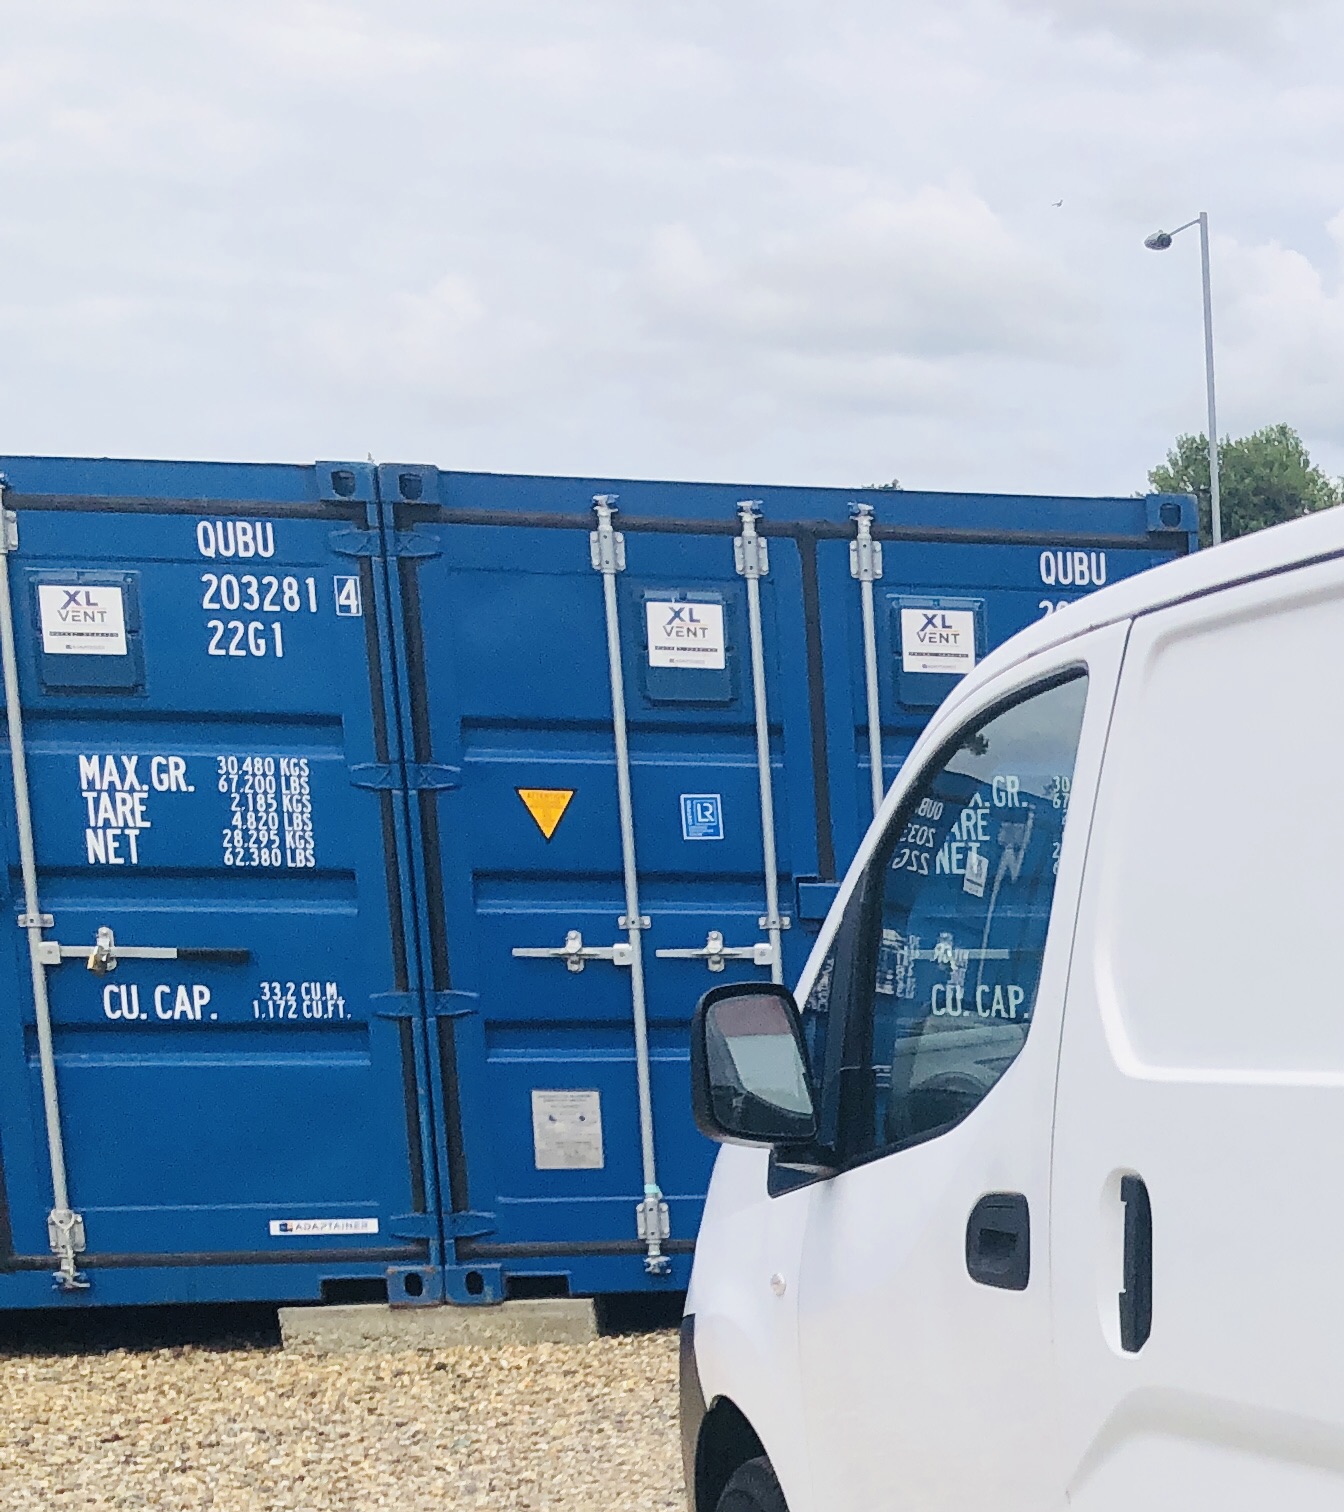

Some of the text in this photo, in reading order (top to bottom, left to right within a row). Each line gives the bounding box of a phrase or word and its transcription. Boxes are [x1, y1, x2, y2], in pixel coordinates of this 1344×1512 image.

[196, 520, 275, 558] QUBU
[1040, 551, 1106, 586] QUBU
[60, 590, 99, 609] XL
[201, 573, 358, 614] 203281 4
[57, 610, 107, 622] VENT
[665, 606, 701, 625] XL
[919, 613, 953, 632] XL
[207, 619, 283, 658] 22G1
[662, 625, 709, 638] VENT
[916, 632, 960, 644] VENT
[280, 757, 310, 776] KGS
[281, 776, 310, 794] LBS
[81, 791, 152, 828] TARE
[282, 794, 312, 813] KGS
[284, 812, 313, 831] LBS
[85, 828, 141, 865] NET
[285, 830, 315, 849] KGS
[286, 848, 316, 868] LBS
[154, 984, 218, 1020] CAP.
